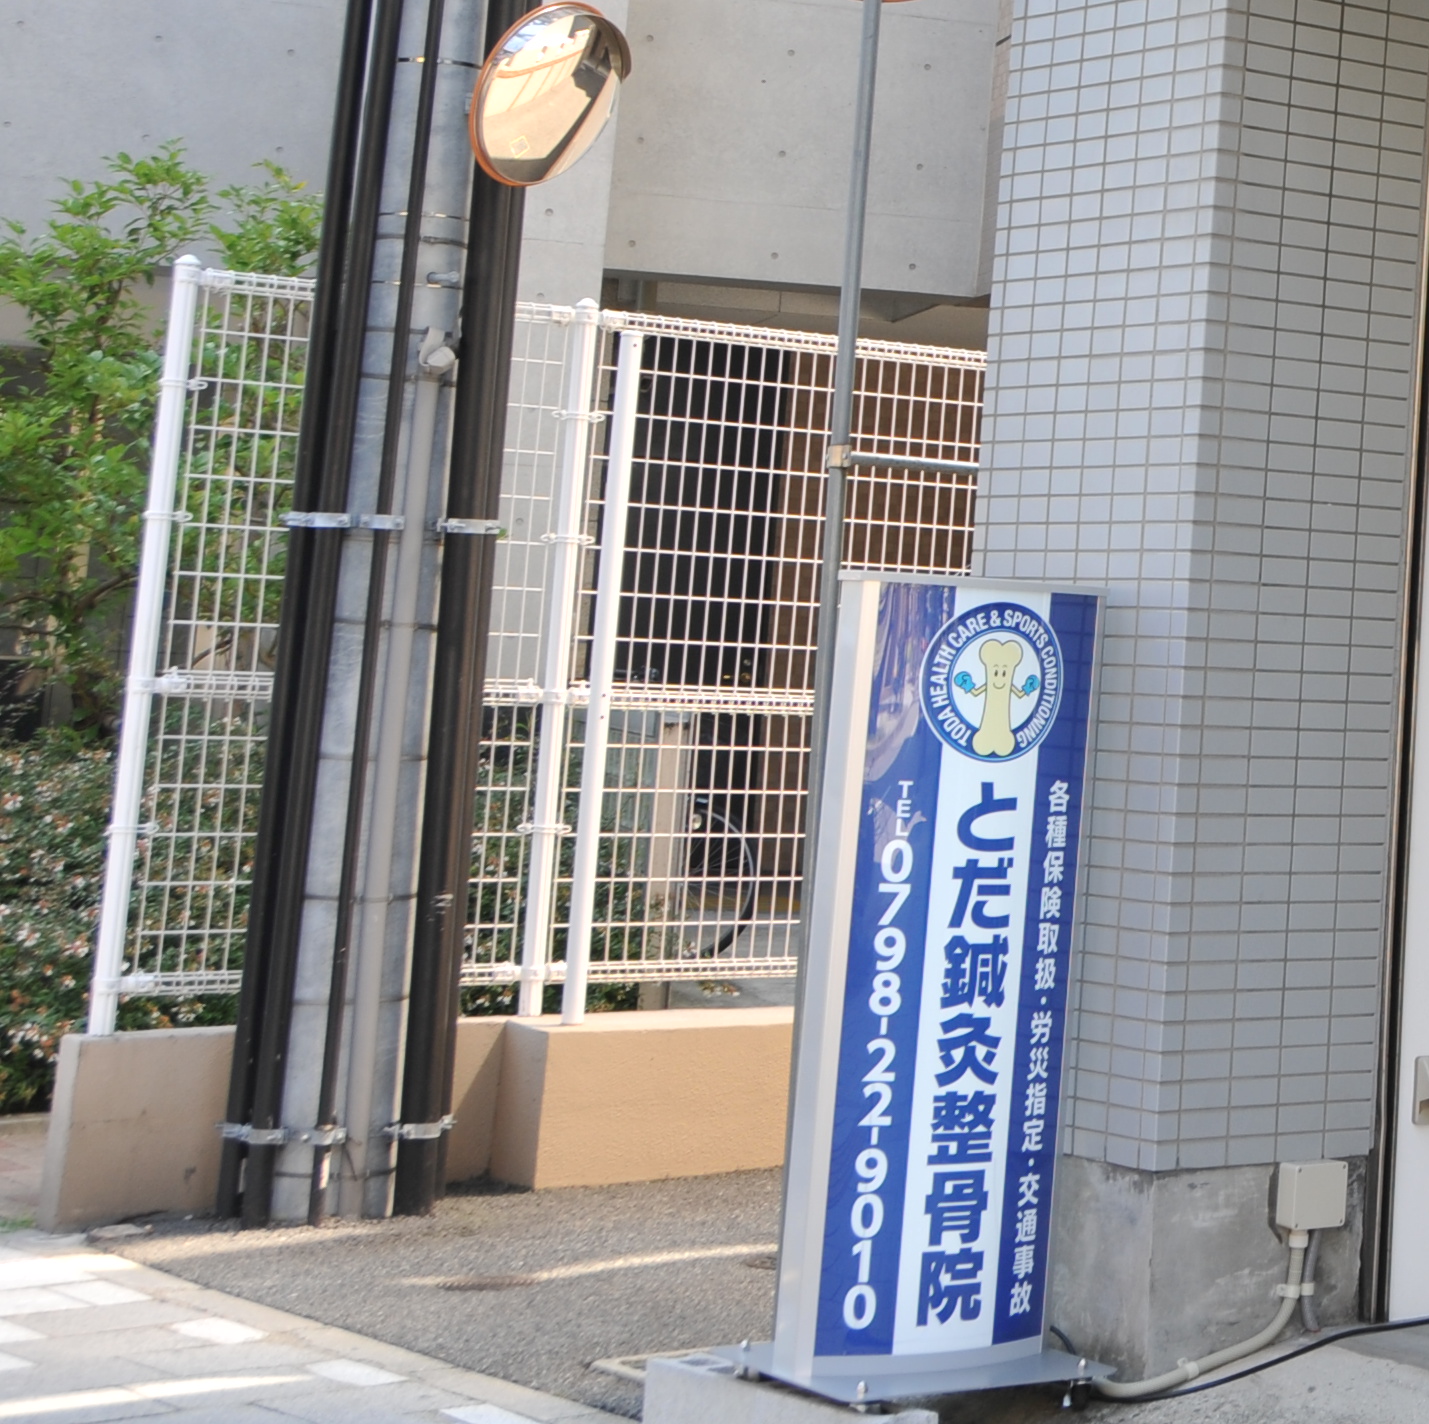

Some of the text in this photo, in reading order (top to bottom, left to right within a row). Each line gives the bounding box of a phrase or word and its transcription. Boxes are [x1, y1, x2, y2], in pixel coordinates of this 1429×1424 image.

[929, 609, 1058, 748] TODA HEALTH CARE & SPORTS CONDITIONING
[843, 780, 914, 1330] TEL 0798-22-9010
[916, 782, 1018, 1328] とだ鍼灸整骨院
[1009, 780, 1070, 1318] 各種保険取扱・労災指定・交通事故
